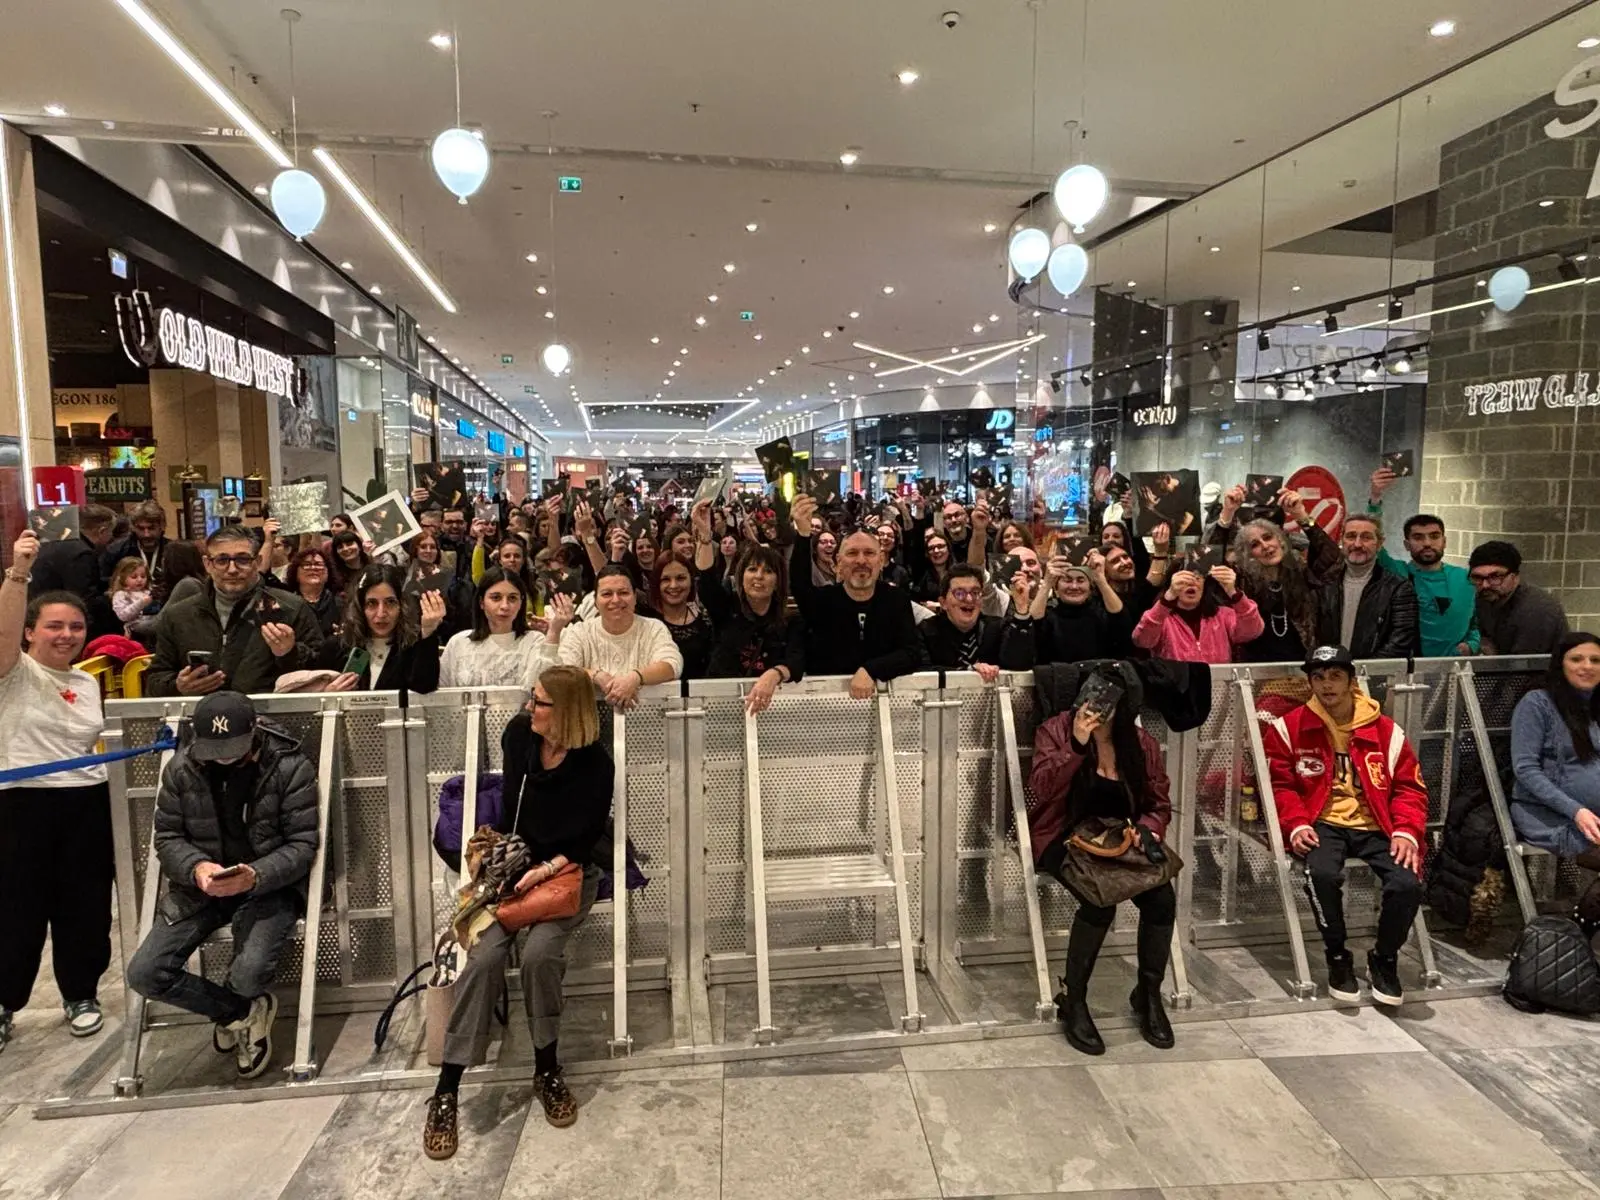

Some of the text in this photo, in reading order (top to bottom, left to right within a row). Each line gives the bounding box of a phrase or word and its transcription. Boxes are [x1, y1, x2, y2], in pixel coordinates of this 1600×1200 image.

[159, 307, 294, 399] OLD WILD WEST
[986, 409, 1014, 430] JD
[36, 483, 71, 506] L1
[84, 476, 145, 494] EANUTS
[212, 716, 229, 734] NY
